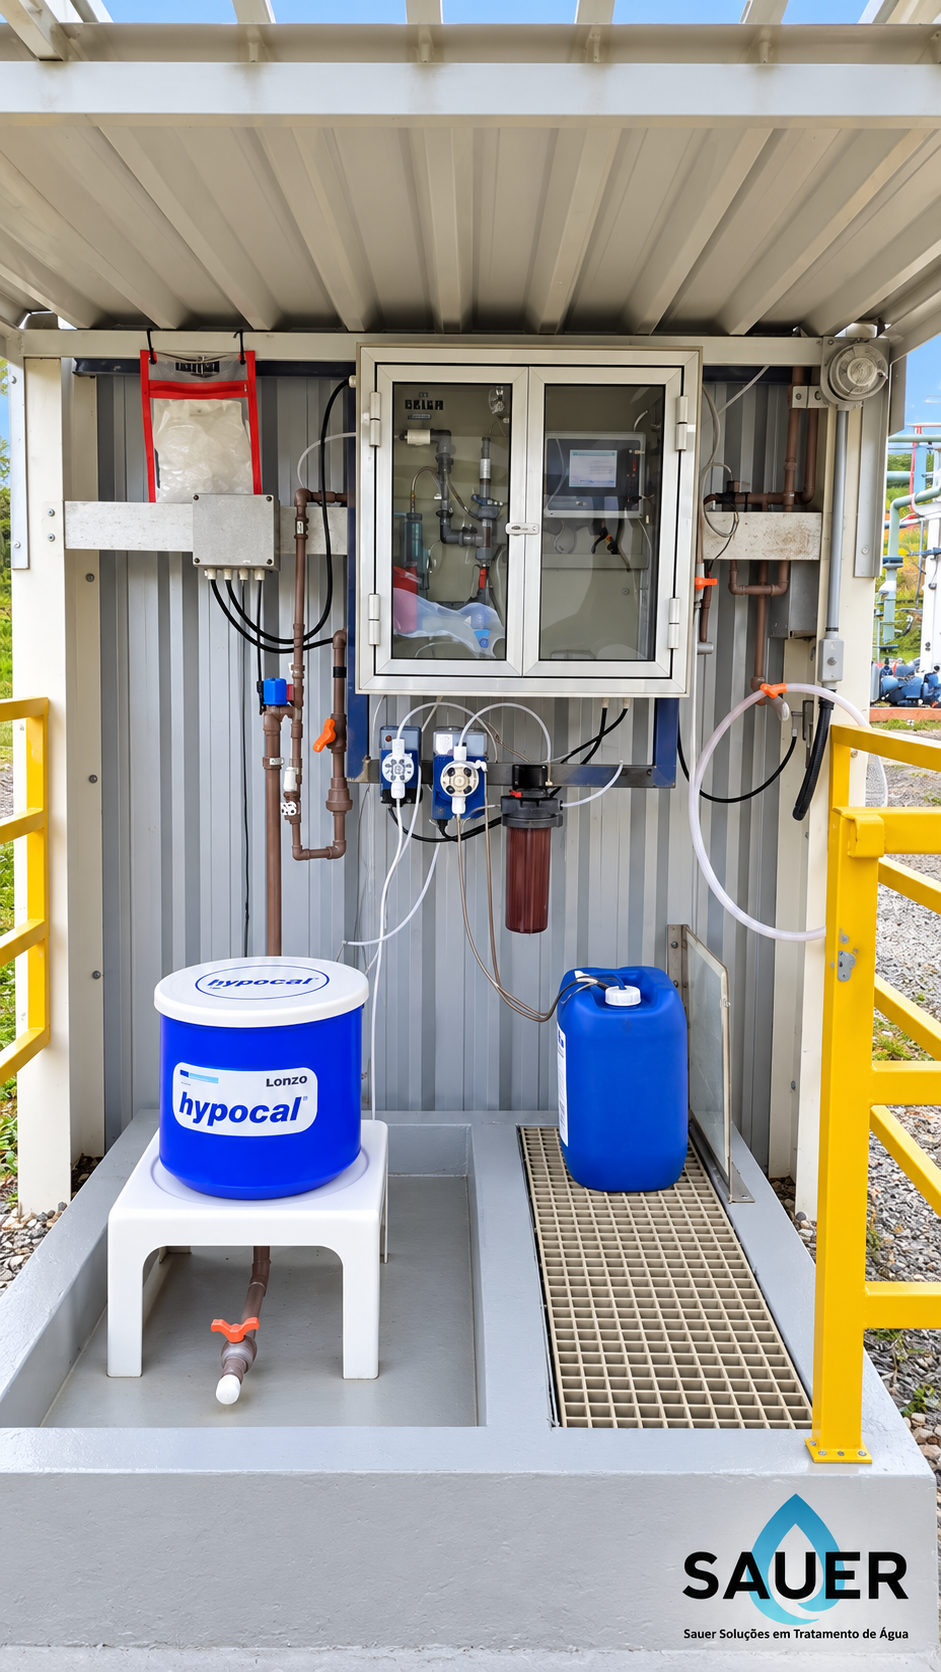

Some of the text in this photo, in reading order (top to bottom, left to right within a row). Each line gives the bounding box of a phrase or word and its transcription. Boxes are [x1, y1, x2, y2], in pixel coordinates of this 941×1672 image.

[207, 977, 314, 988] hypocal
[265, 1075, 308, 1088] Lonzo
[179, 1091, 302, 1127] hypocal
